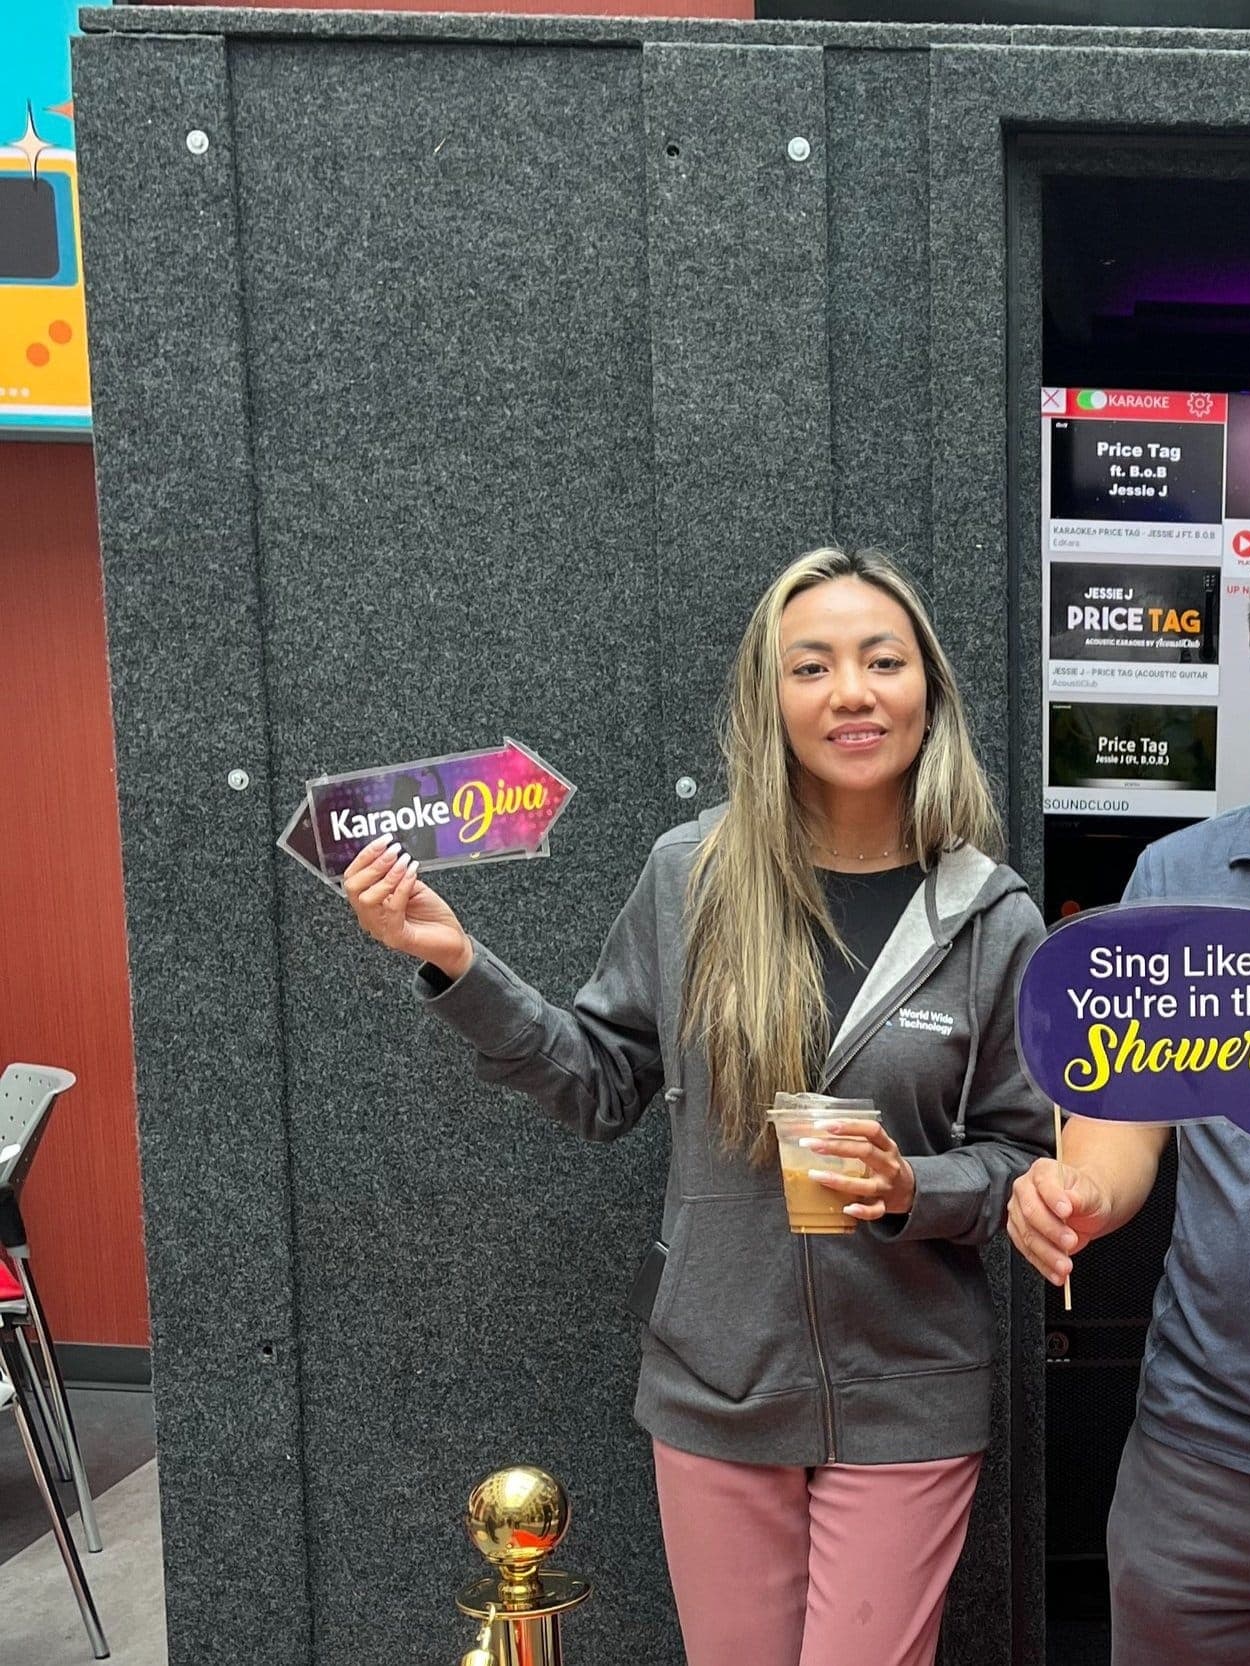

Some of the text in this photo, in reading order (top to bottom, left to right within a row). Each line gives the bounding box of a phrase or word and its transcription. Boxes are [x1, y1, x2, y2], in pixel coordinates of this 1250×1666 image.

[1108, 394, 1170, 409] KARAOKE
[1097, 441, 1181, 462] Price Tag
[1110, 465, 1168, 478] ft. B.o.B
[1109, 483, 1168, 496] Jessie J
[1098, 527, 1123, 537] PRICE
[1125, 528, 1141, 537] TAG
[1147, 529, 1174, 538] JESSIE
[1084, 587, 1134, 600] JESSIE J
[1227, 585, 1240, 594] UP
[1067, 605, 1201, 633] PRICE TAG
[1053, 667, 1078, 675] JESSIE
[1079, 668, 1084, 676] J
[1092, 668, 1115, 677] PRICE
[1118, 669, 1133, 677] TAG
[1135, 669, 1177, 679] (ACOUSTIC
[1179, 671, 1208, 679] GUITAR
[1098, 736, 1168, 756] Price Tag
[1095, 754, 1119, 764] Jessie
[1119, 755, 1124, 764] J
[330, 779, 548, 844] Karaoke Diva
[1043, 799, 1130, 812] SOUNDCLOUD
[1089, 946, 1170, 986] Sing
[1067, 986, 1178, 1019] You're
[1189, 985, 1219, 1017] in
[899, 1007, 954, 1025] World Wide
[899, 1017, 953, 1036] Technology
